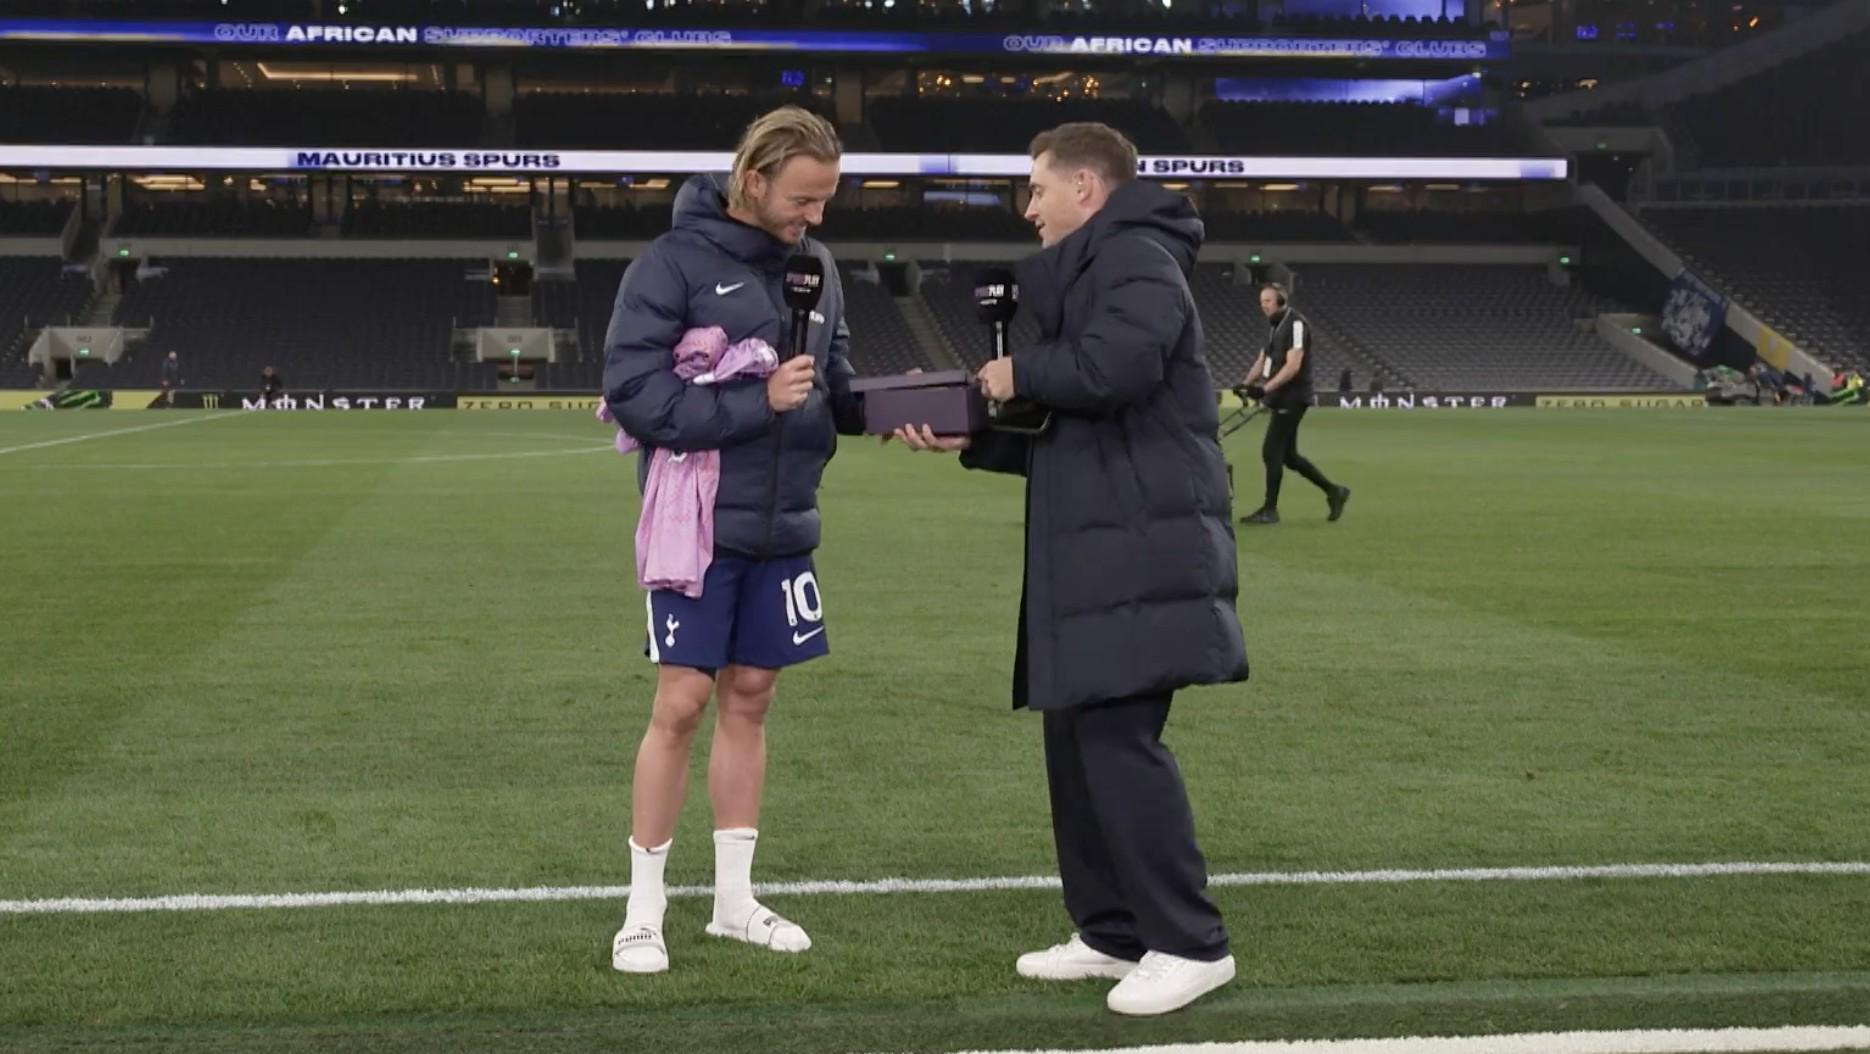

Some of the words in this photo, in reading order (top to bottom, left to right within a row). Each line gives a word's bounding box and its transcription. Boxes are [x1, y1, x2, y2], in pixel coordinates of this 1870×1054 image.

[213, 23, 280, 41] OUR
[285, 25, 418, 43] AFRICAN
[1070, 36, 1193, 53] AFRICAN
[1395, 40, 1487, 57] CLUBS
[297, 152, 456, 167] MAURITIUS
[463, 153, 561, 168] SPURS
[1152, 160, 1245, 173] SPURS
[242, 394, 425, 410] MONSTER
[549, 401, 600, 410] SUG
[1339, 393, 1507, 409] MONSTER
[781, 571, 823, 627] 10
